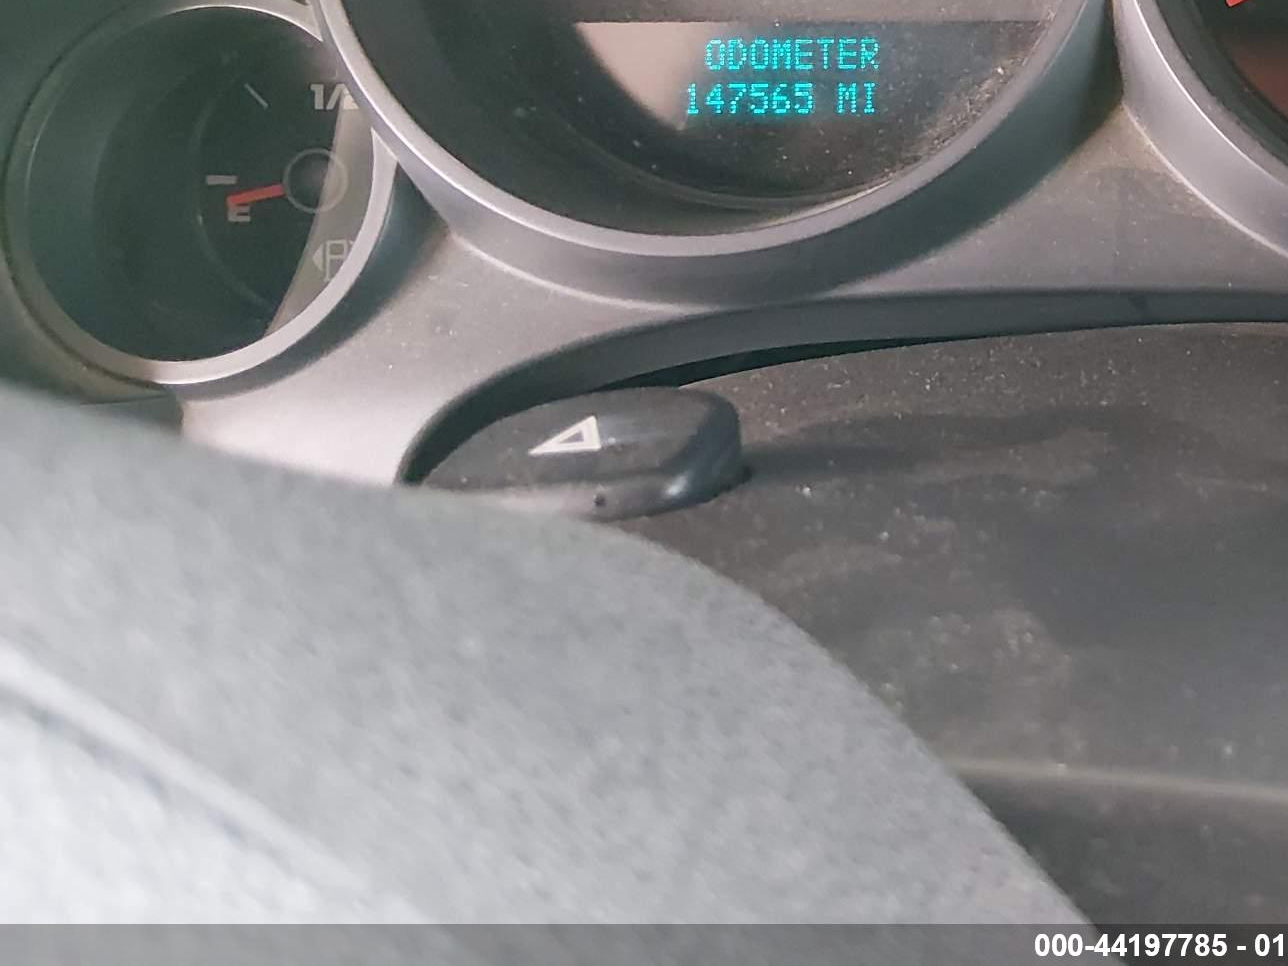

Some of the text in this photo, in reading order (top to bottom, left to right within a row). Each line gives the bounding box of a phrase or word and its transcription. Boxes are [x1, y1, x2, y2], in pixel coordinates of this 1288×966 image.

[705, 39, 880, 70] ODOMETER
[687, 83, 875, 114] 147565 MI
